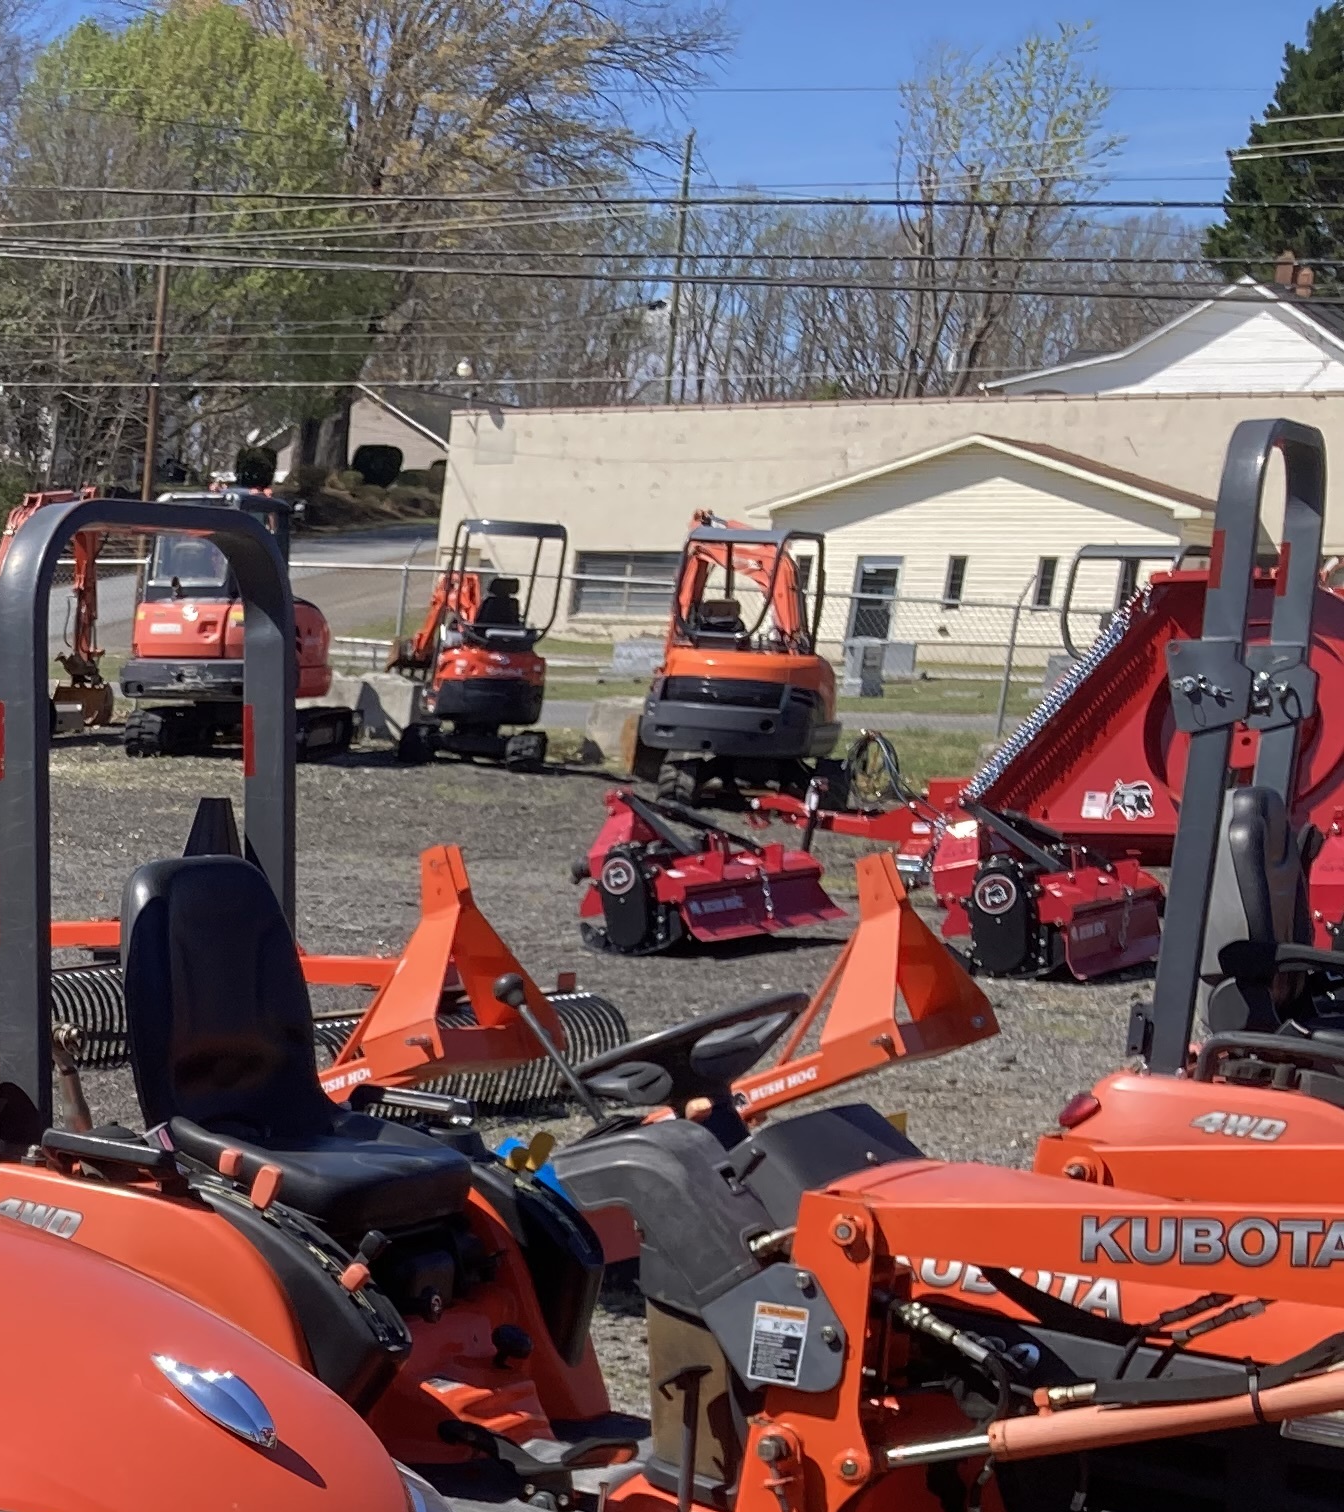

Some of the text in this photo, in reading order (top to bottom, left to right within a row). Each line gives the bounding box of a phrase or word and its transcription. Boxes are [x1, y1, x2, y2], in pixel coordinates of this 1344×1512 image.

[749, 1066, 818, 1103] BUSH HOG
[1189, 1109, 1289, 1142] 4WD
[1080, 1214, 1344, 1269] KUBOTA
